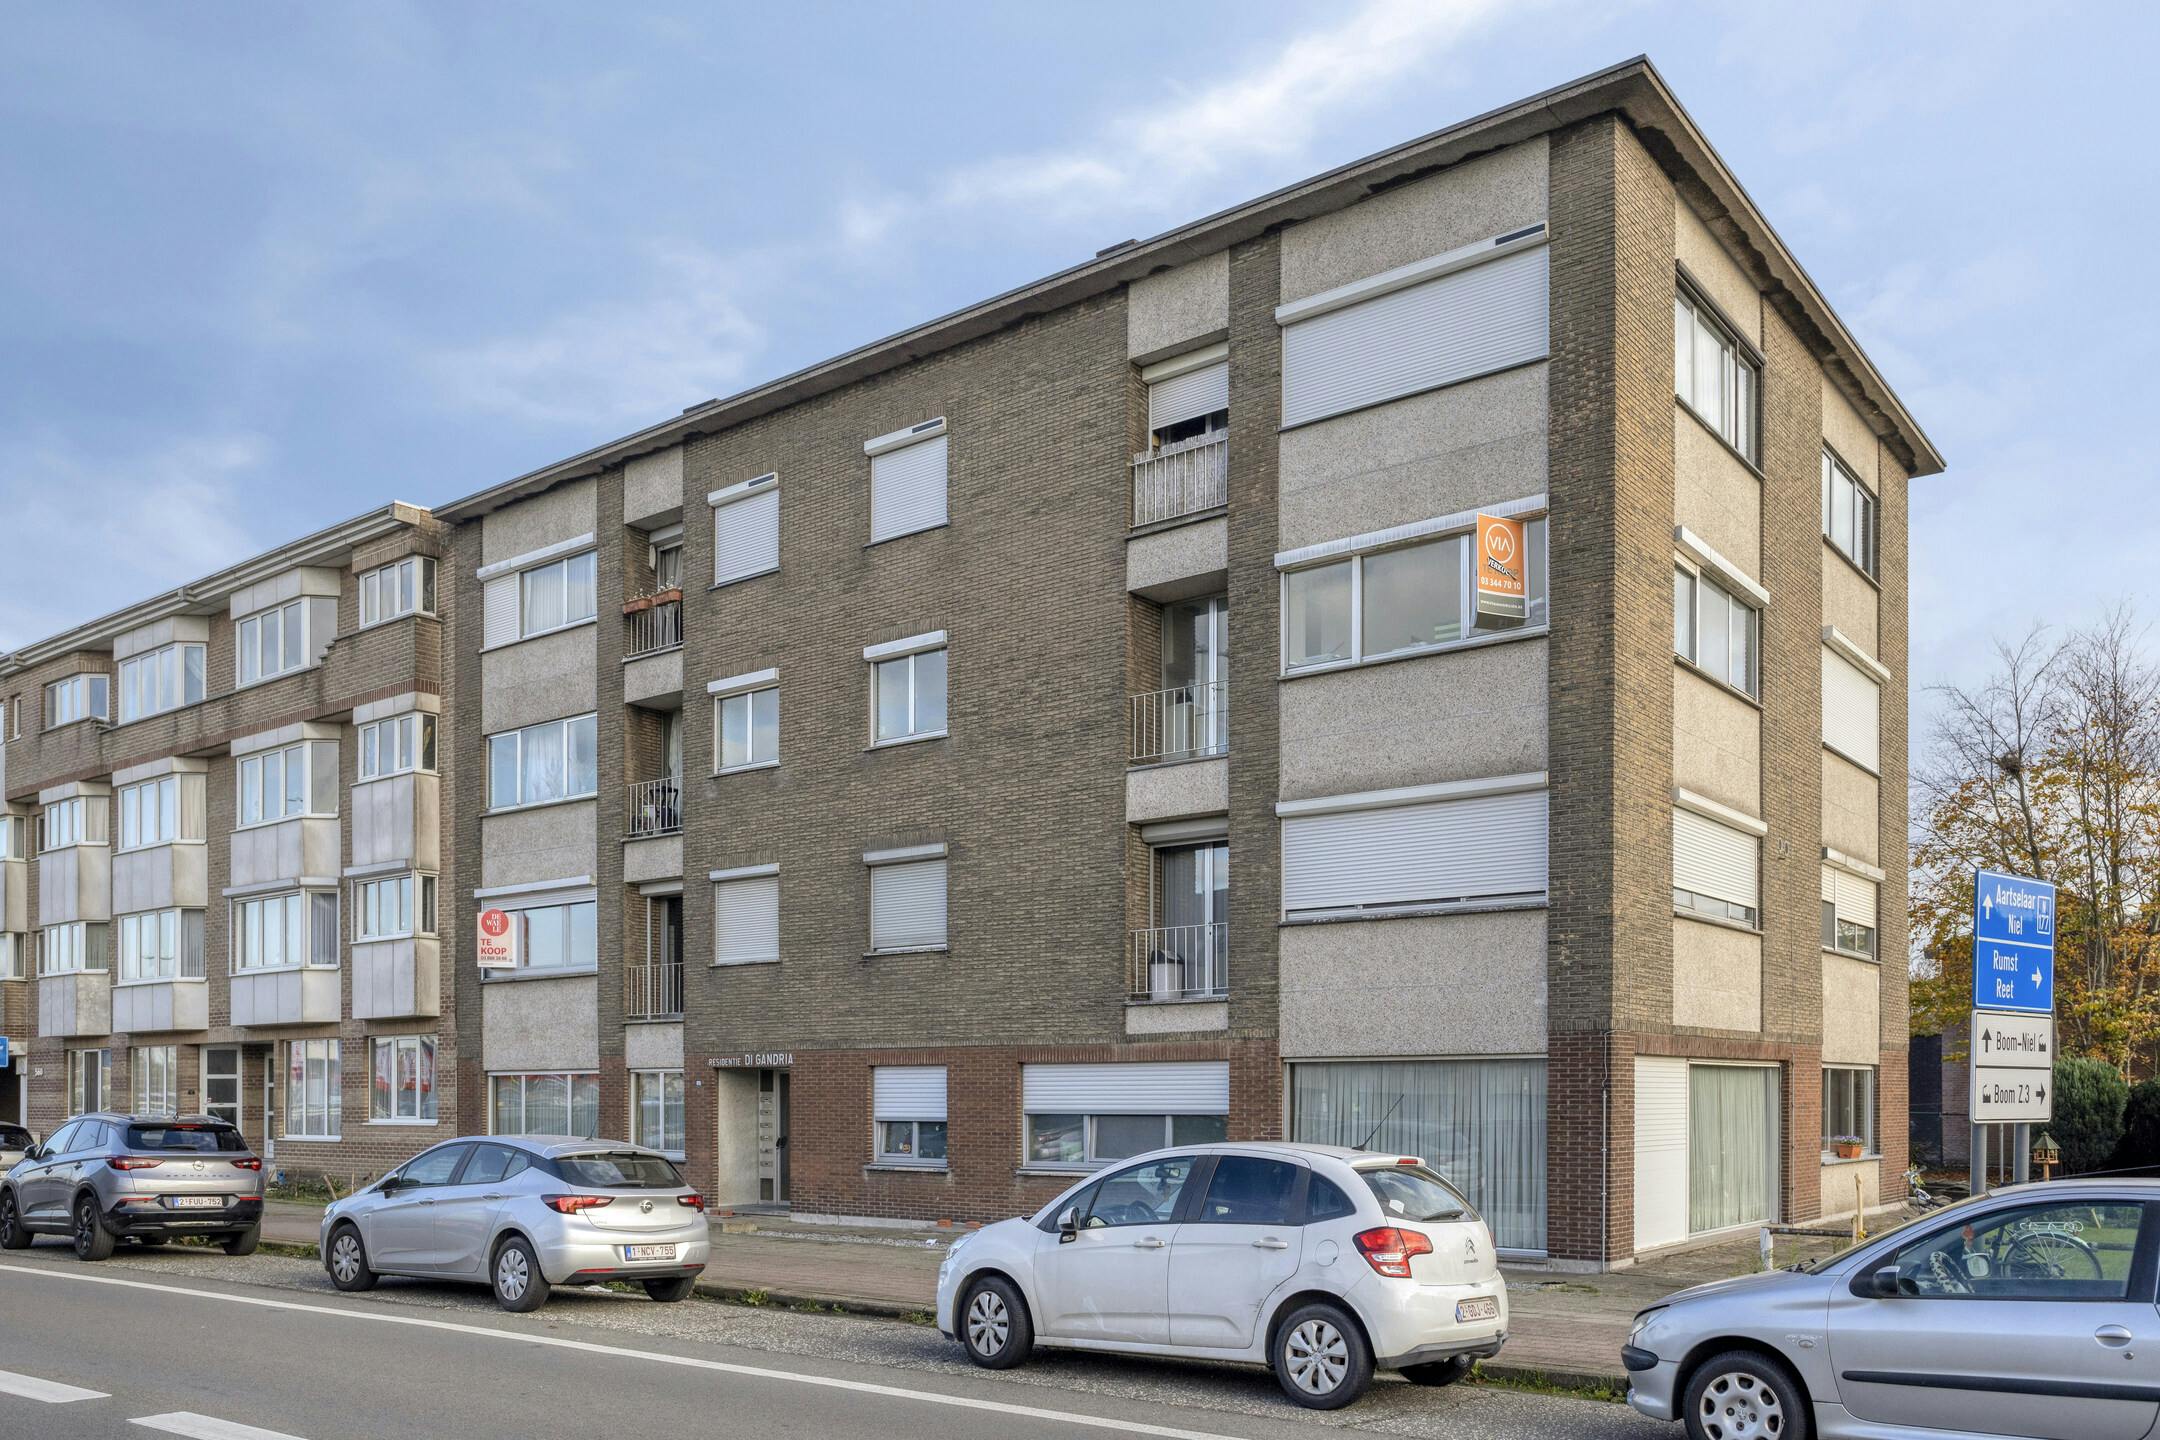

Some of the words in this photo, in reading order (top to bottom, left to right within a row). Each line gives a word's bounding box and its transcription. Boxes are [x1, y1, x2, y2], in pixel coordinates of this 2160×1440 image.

[1489, 534, 1511, 552] VIA
[1480, 576, 1489, 585] 03
[1490, 578, 1502, 587] 344
[1503, 580, 1512, 589] 70
[1513, 581, 1521, 590] 10
[1995, 884, 2035, 910] Aartselaar
[2008, 914, 2023, 935] Niel
[2038, 915, 2049, 930] 177
[480, 938, 492, 946] TE
[480, 947, 507, 955] KOOP
[1993, 950, 2018, 972] Rumst
[1996, 978, 2014, 999] Reet
[1996, 1031, 2036, 1052] Boom-Niel
[708, 1057, 742, 1066] RESIDENTIE
[745, 1054, 753, 1066] DI
[755, 1053, 793, 1065] GANDRIA
[1994, 1084, 2015, 1104] Boom
[2018, 1084, 2030, 1104] Z.3
[632, 1246, 674, 1257] 1-NCV-755
